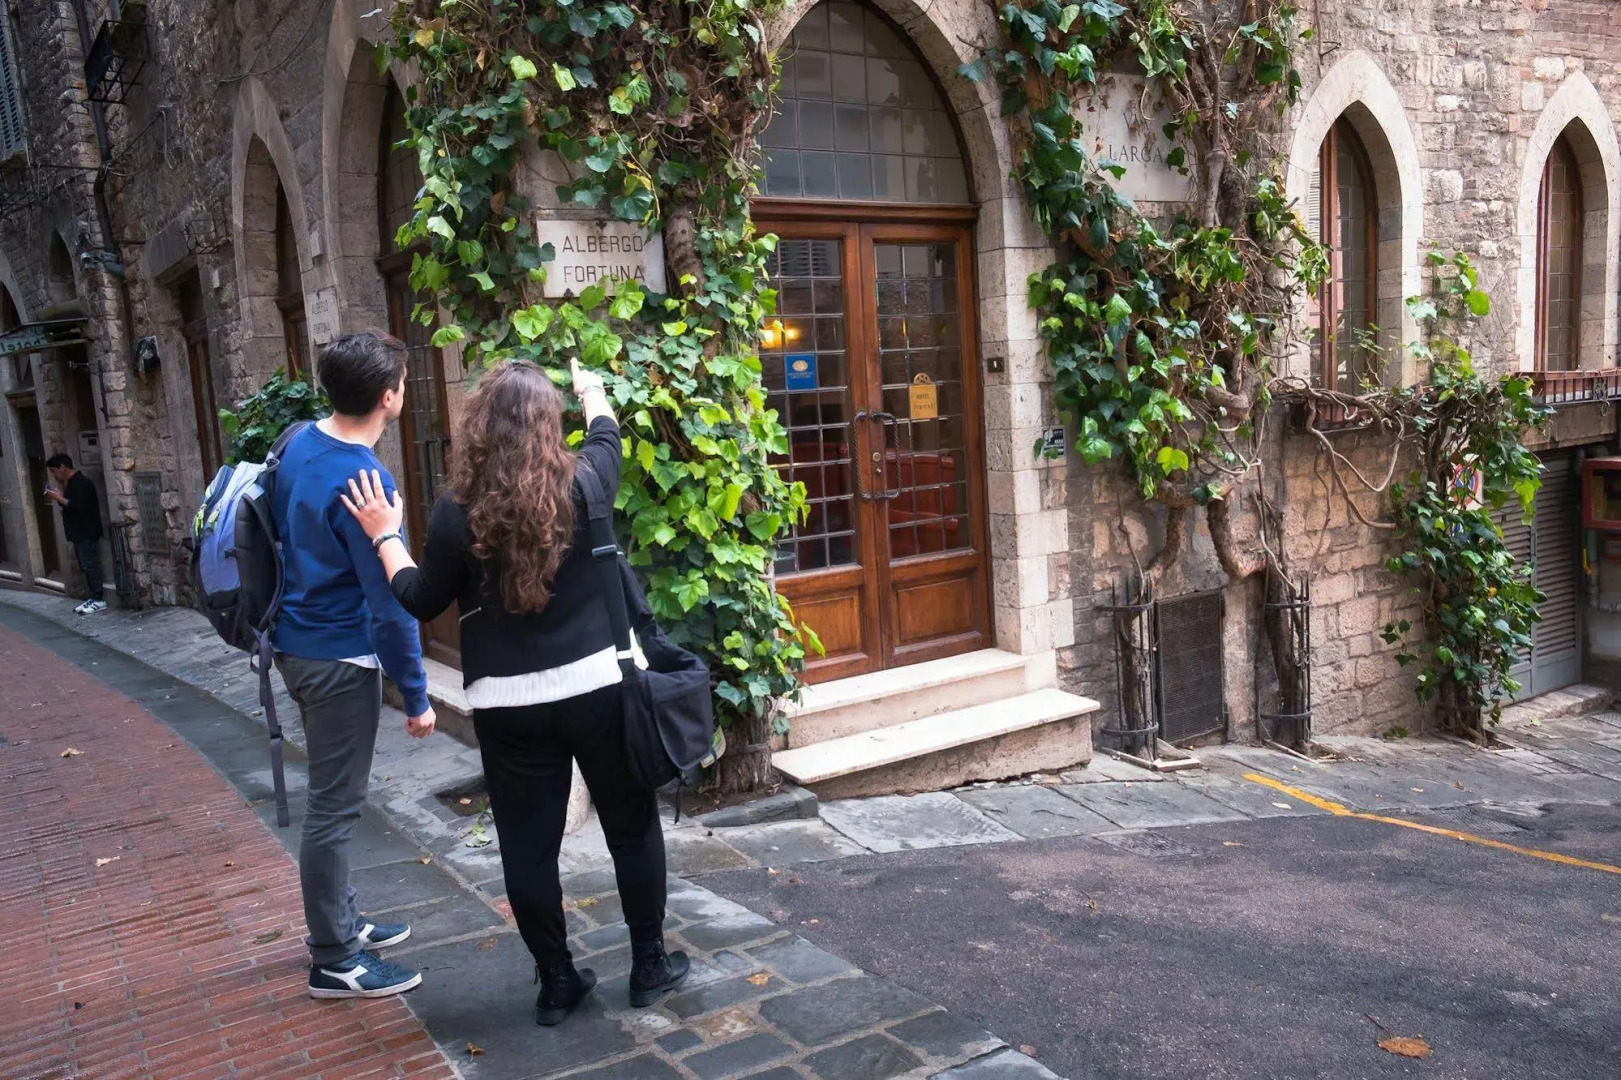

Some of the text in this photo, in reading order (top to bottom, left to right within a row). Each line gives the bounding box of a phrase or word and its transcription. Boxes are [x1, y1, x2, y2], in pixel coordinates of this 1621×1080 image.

[1109, 144, 1163, 162] LARGA
[562, 235, 644, 253] ALBERGO
[563, 265, 646, 282] FORTUNA
